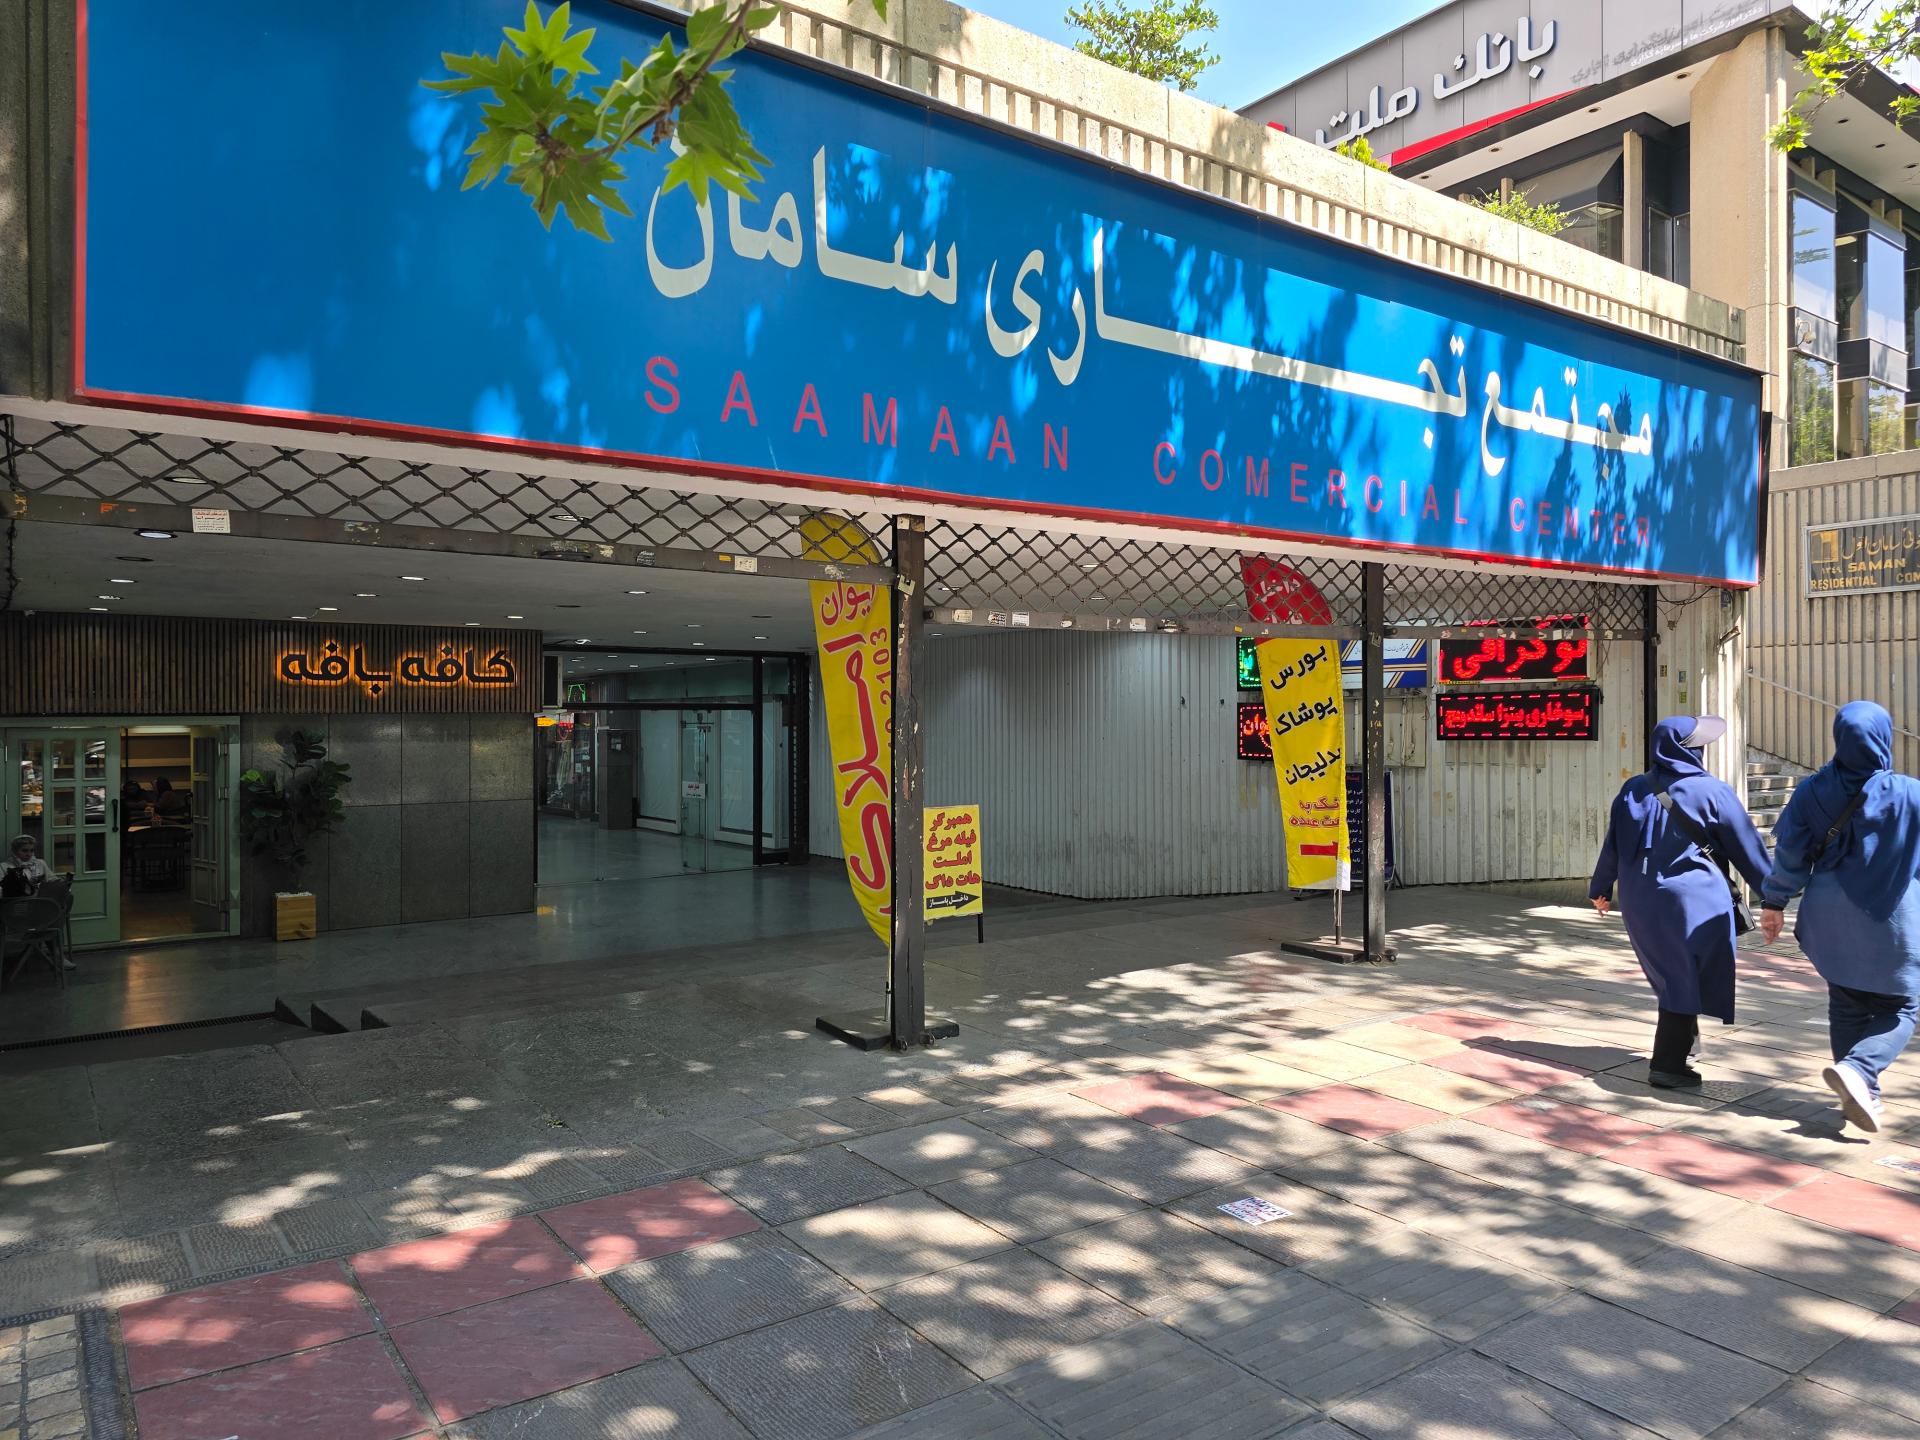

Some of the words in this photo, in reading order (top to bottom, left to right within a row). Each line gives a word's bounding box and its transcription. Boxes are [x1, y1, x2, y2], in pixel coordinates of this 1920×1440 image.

[1315, 84, 1417, 150] ملت
[646, 127, 958, 304] سامان
[985, 227, 1467, 448] تجاری
[1482, 366, 1652, 477] مجتمع
[644, 356, 1069, 471] SAAMAN
[1153, 441, 1468, 525] COMERCIAL
[1510, 502, 1650, 548] CENTER
[1810, 575, 1877, 591] RESIDENTIAL
[1848, 558, 1906, 573] SAMAN
[280, 642, 393, 695] بافه
[399, 642, 516, 685] کافه
[1270, 645, 1328, 690] بورس
[1275, 696, 1338, 737] پوشاک
[1496, 702, 1525, 728] پیتزا
[1525, 701, 1585, 728] سوخاری
[926, 832, 953, 852] مرغ
[954, 828, 977, 848] فیله
[932, 849, 973, 869] املت
[956, 870, 981, 887] هات
